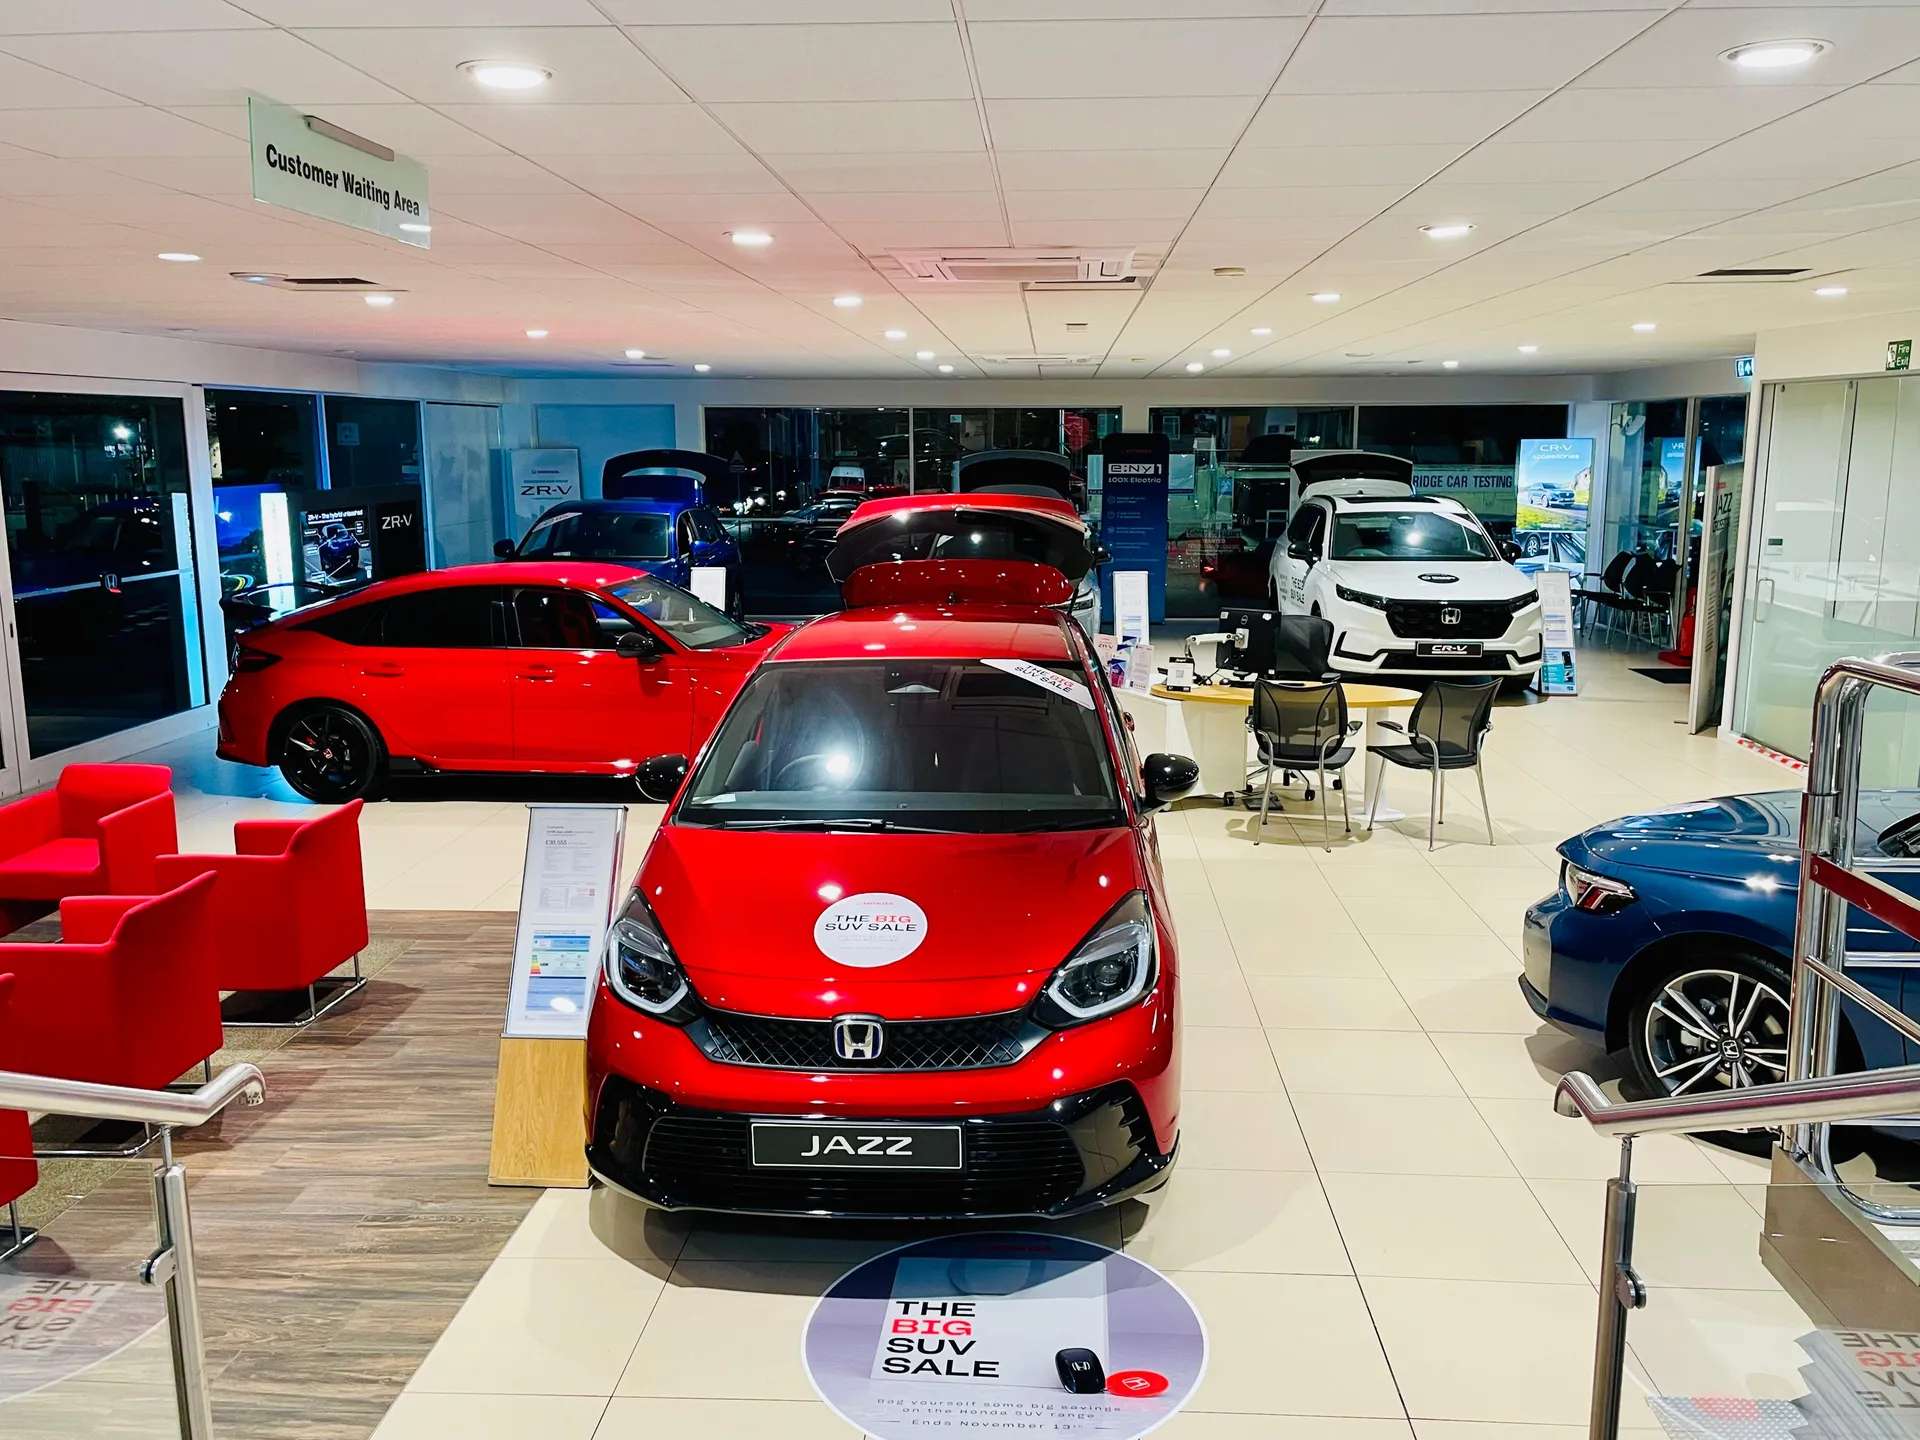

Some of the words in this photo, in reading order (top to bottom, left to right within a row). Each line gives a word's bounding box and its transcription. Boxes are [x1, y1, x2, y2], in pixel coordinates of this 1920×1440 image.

[266, 144, 339, 189] Customer
[342, 170, 390, 210] Waiting
[394, 190, 420, 216] Area
[1898, 344, 1910, 353] Fire
[1896, 356, 1909, 366] Exit
[1447, 475, 1468, 488] CAR
[1473, 475, 1512, 488] TESTING
[521, 485, 573, 496] ZR-V
[1713, 492, 1733, 521] JAZZ
[382, 513, 413, 530] ZR-V
[1026, 665, 1049, 676] THE
[1015, 666, 1038, 678] SUV
[1040, 677, 1073, 693] SALE
[835, 914, 870, 922] THE
[875, 914, 911, 923] BIG
[825, 922, 863, 931] SUV
[868, 922, 917, 931] SALE
[801, 1135, 913, 1157] JAZZ
[896, 1301, 976, 1317] THE
[892, 1319, 973, 1336] BIG
[886, 1337, 977, 1355] SUV
[882, 1357, 1000, 1378] SALE
[960, 1408, 1008, 1416] Honda
[1050, 1412, 1094, 1420] range
[1031, 1402, 1054, 1411] big
[1061, 1404, 1121, 1413] savings
[912, 1419, 952, 1427] Ends
[960, 1420, 1045, 1430] November
